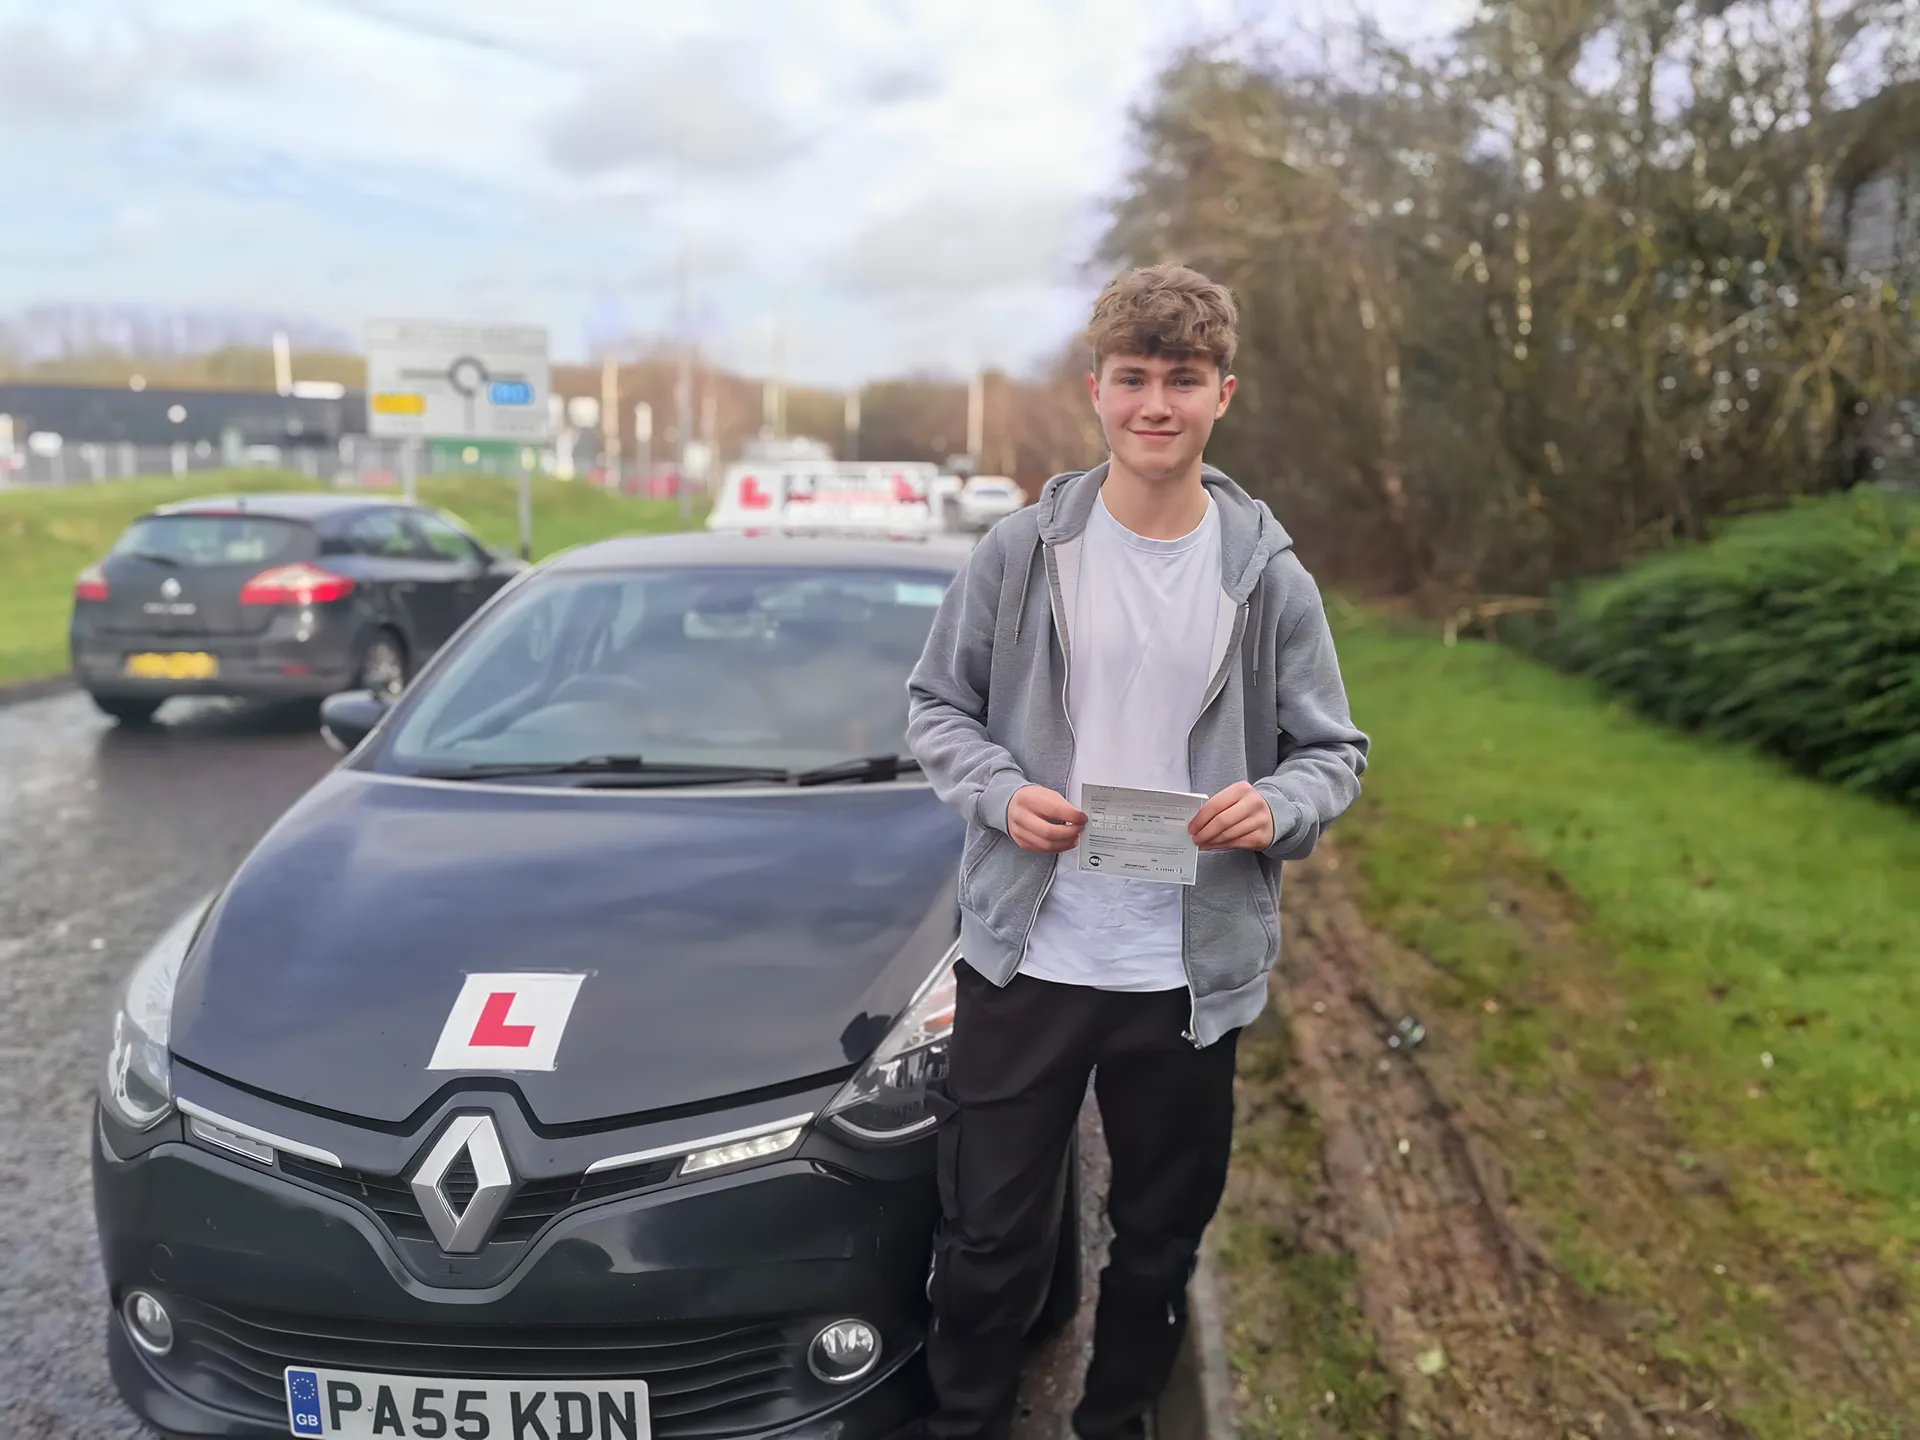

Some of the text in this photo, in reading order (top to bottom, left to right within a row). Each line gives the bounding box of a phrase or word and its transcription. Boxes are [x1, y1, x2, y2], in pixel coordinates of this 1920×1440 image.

[739, 475, 772, 509] L
[468, 992, 537, 1047] L
[296, 1413, 319, 1426] GB
[326, 1380, 637, 1440] PA55 KDN
